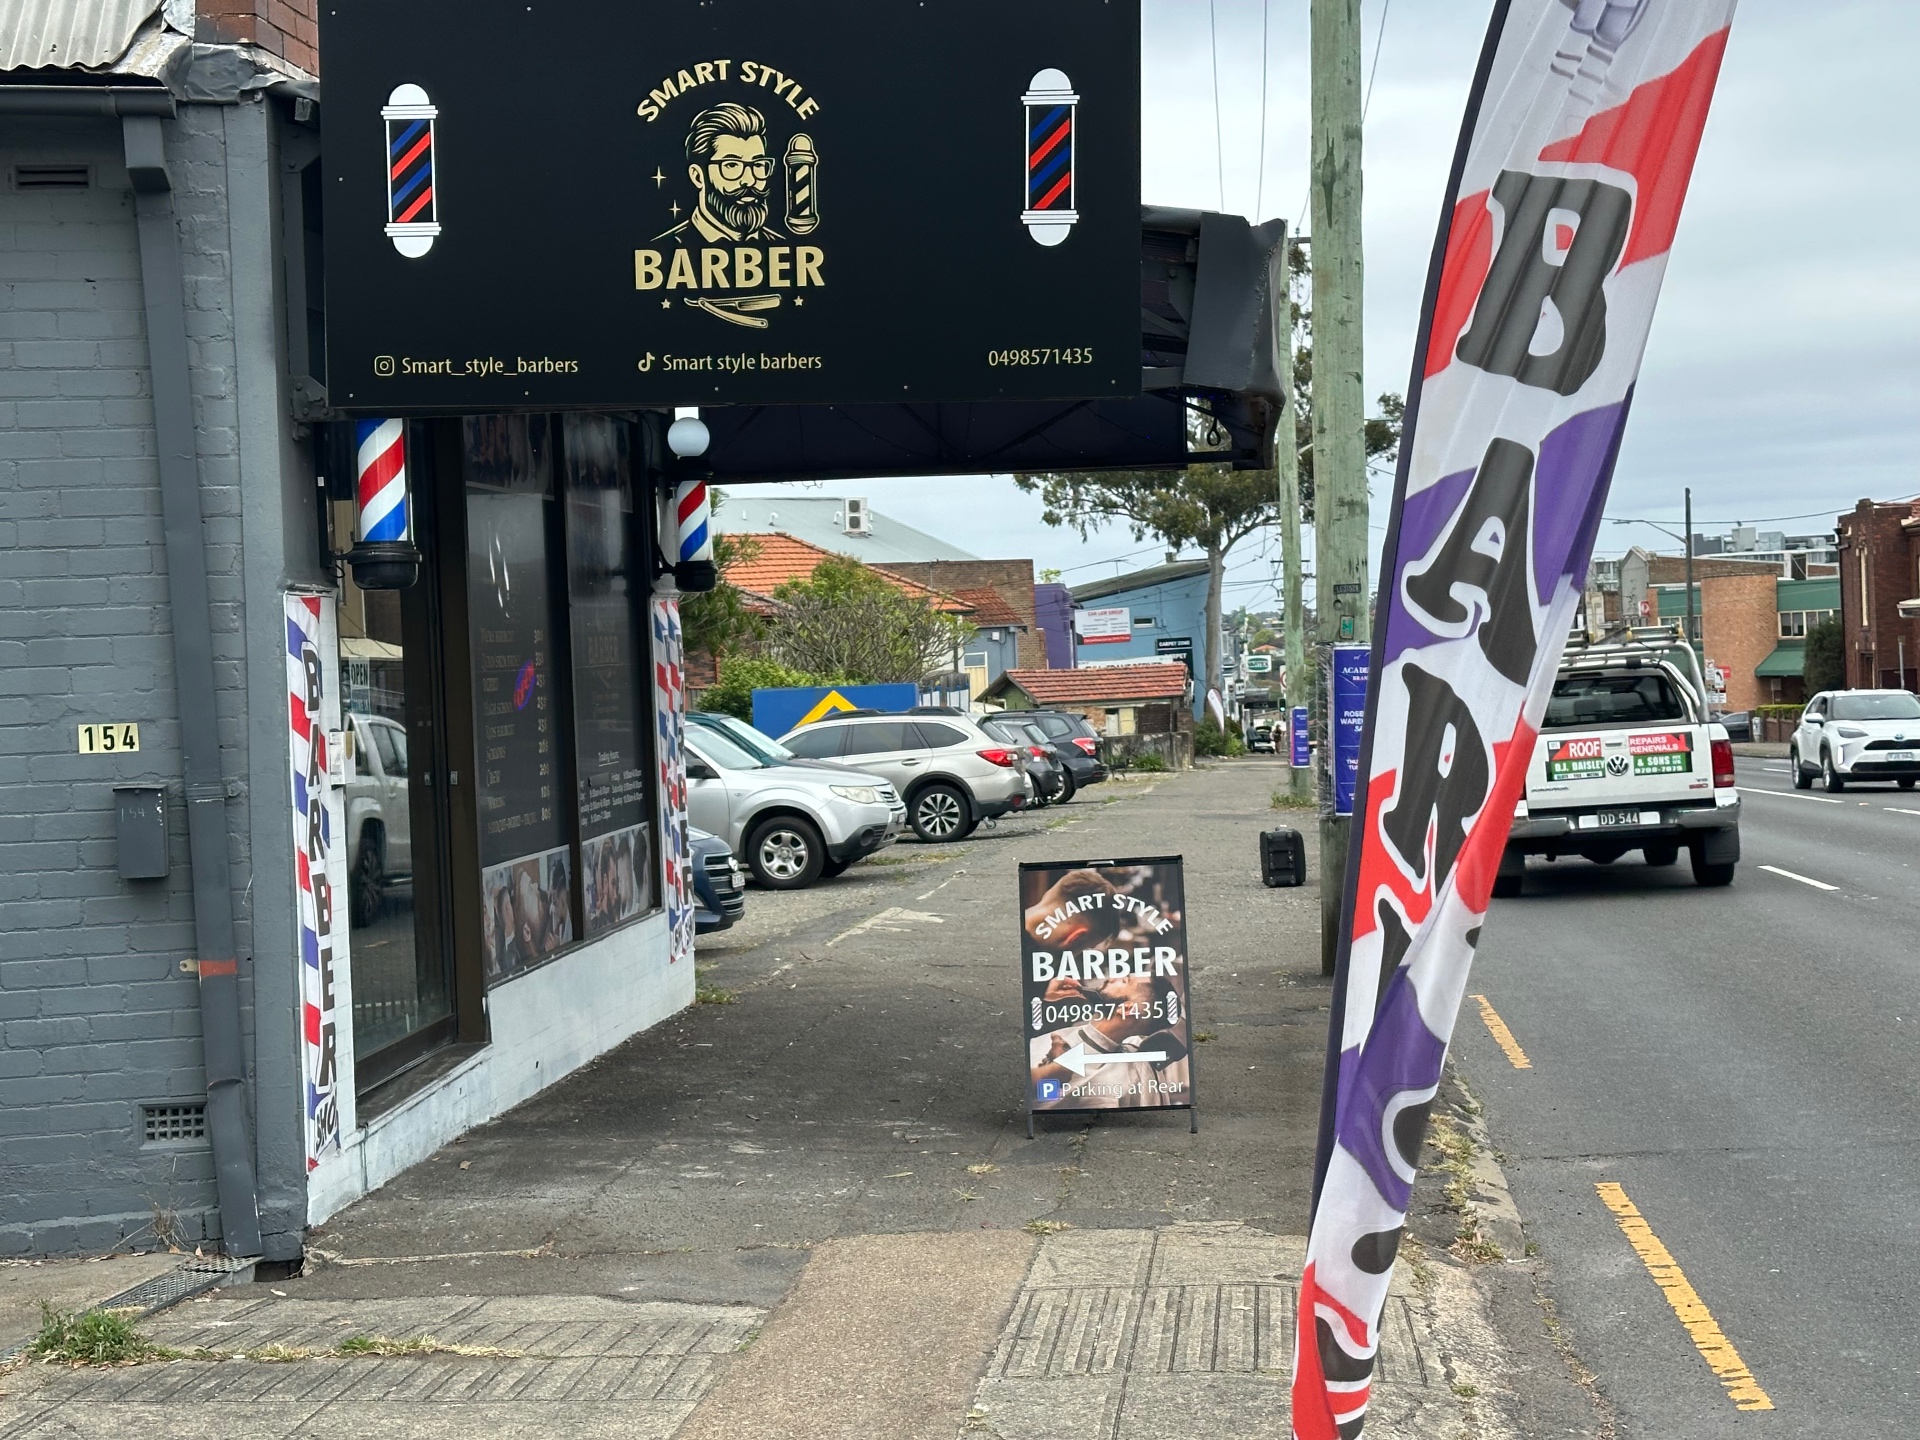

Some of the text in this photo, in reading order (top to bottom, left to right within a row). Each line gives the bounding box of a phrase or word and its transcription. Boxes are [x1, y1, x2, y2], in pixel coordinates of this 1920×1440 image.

[637, 59, 821, 124] SMART STYLE
[634, 245, 825, 292] BARBER
[401, 354, 579, 378] Smart_style_barbers
[662, 351, 823, 374] Smart style barbers
[987, 347, 1093, 367] 0498571435
[351, 663, 369, 686] OPEN
[1342, 666, 1369, 674] ACADE
[1344, 710, 1364, 718] ROSE
[82, 726, 136, 751] 154
[1568, 742, 1601, 758] ROOF
[1629, 736, 1667, 745] REPAIRS
[1630, 743, 1679, 754] RENEWALS
[1554, 762, 1569, 772] D.J.
[1571, 760, 1605, 772] DAISLEY
[1647, 755, 1671, 766] SONS
[1600, 812, 1639, 825] DD 544
[302, 648, 338, 1087] BARBER
[1035, 893, 1173, 941] SMART STYLE
[1032, 946, 1178, 983] BARBER
[1045, 1001, 1164, 1024] 0498571435
[1062, 1082, 1123, 1099] Parking
[1128, 1081, 1143, 1095] at
[1148, 1079, 1184, 1094] Rear
[316, 1095, 337, 1154] SHO
